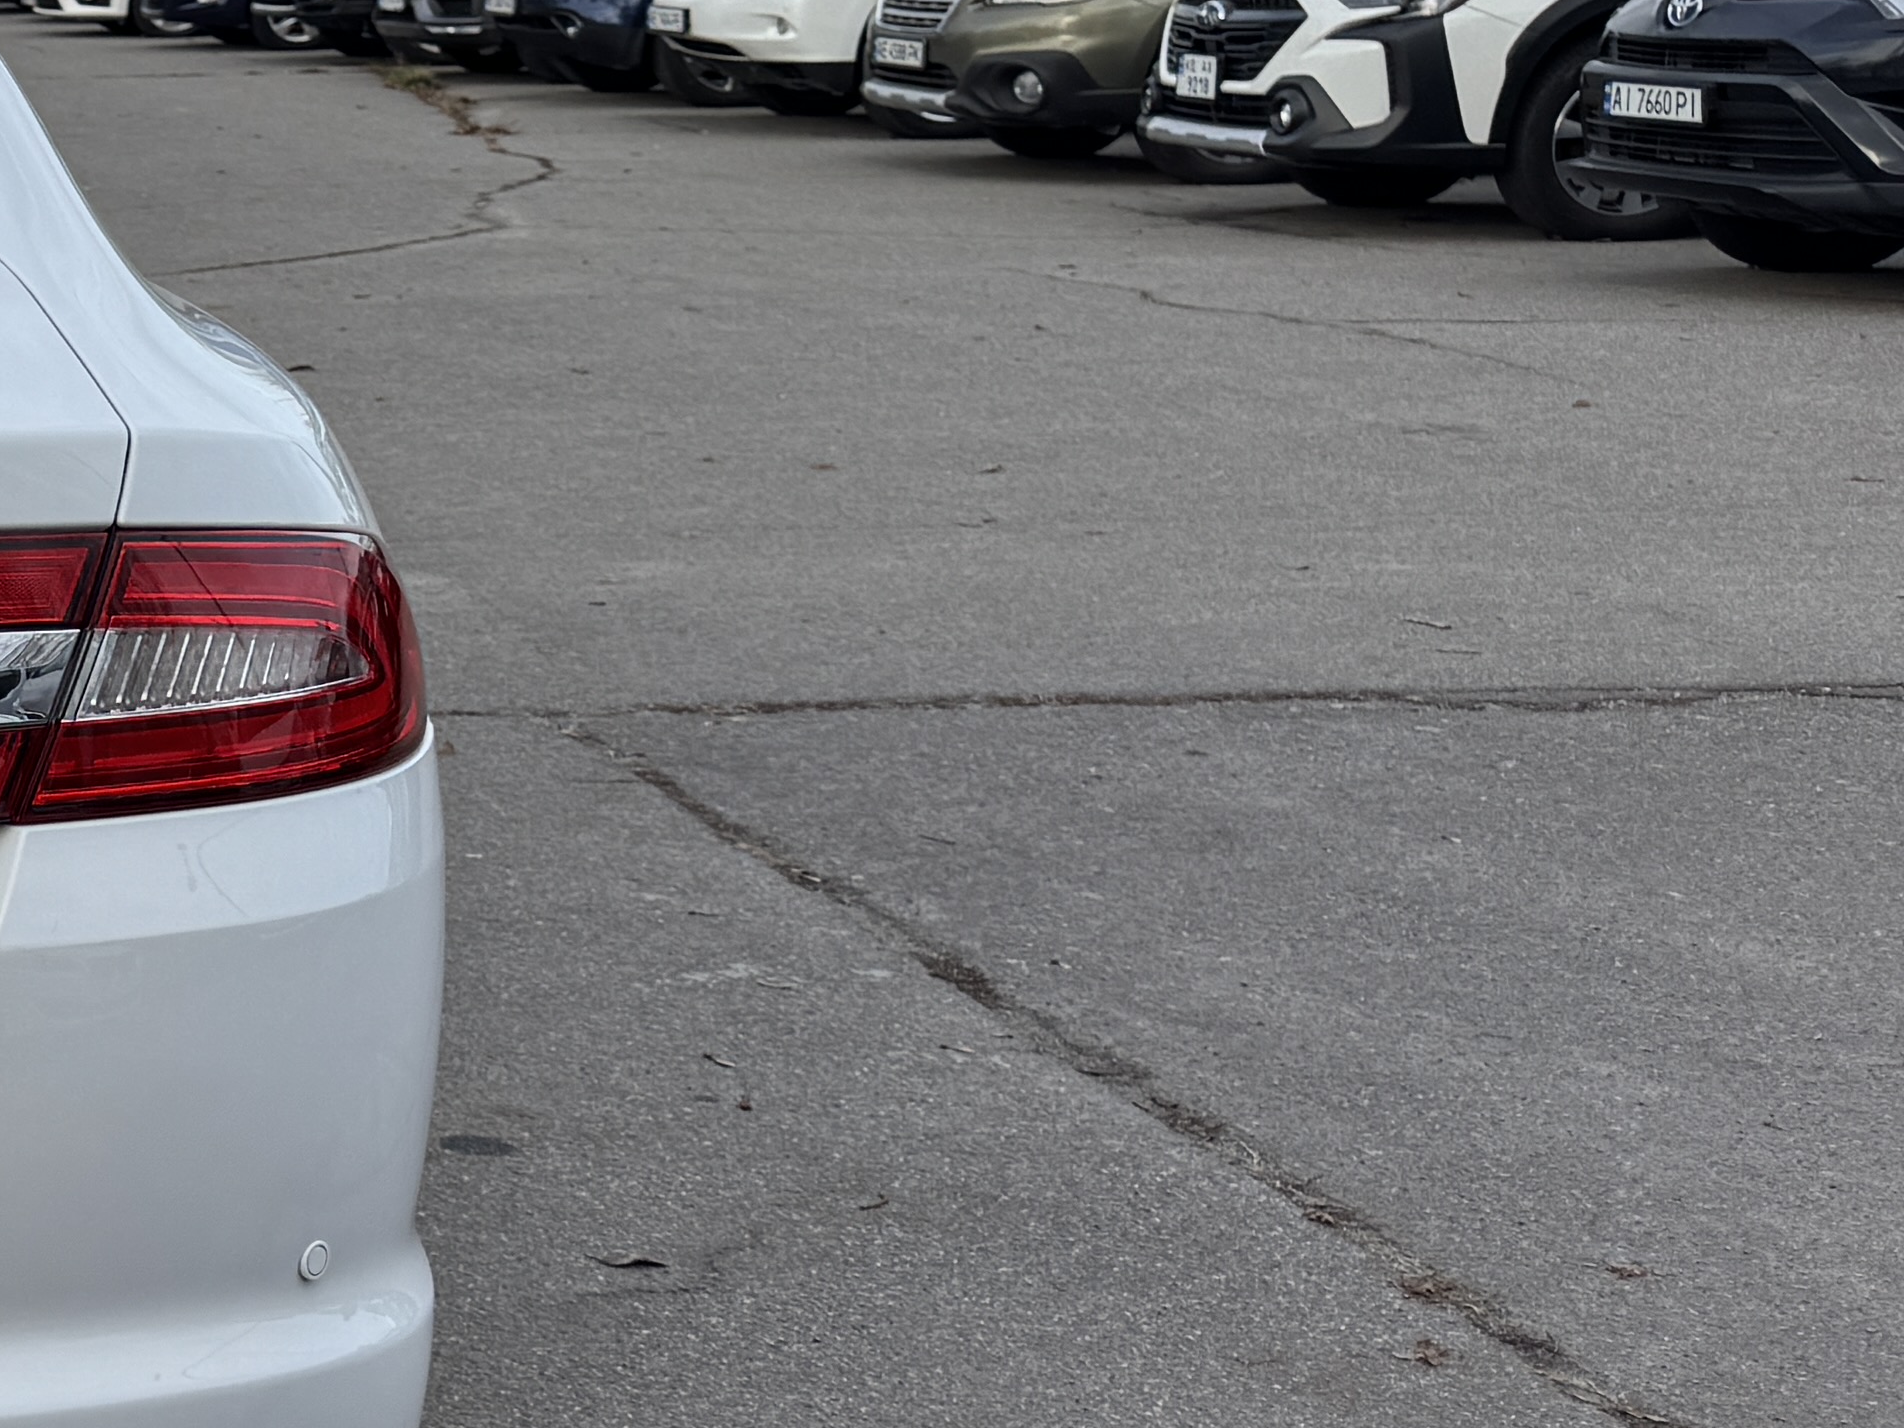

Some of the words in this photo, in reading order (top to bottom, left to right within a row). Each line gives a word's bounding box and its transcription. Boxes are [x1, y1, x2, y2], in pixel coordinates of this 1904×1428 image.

[1612, 86, 1630, 111] AI
[1637, 88, 1672, 115] 7660
[1676, 91, 1695, 118] PI
